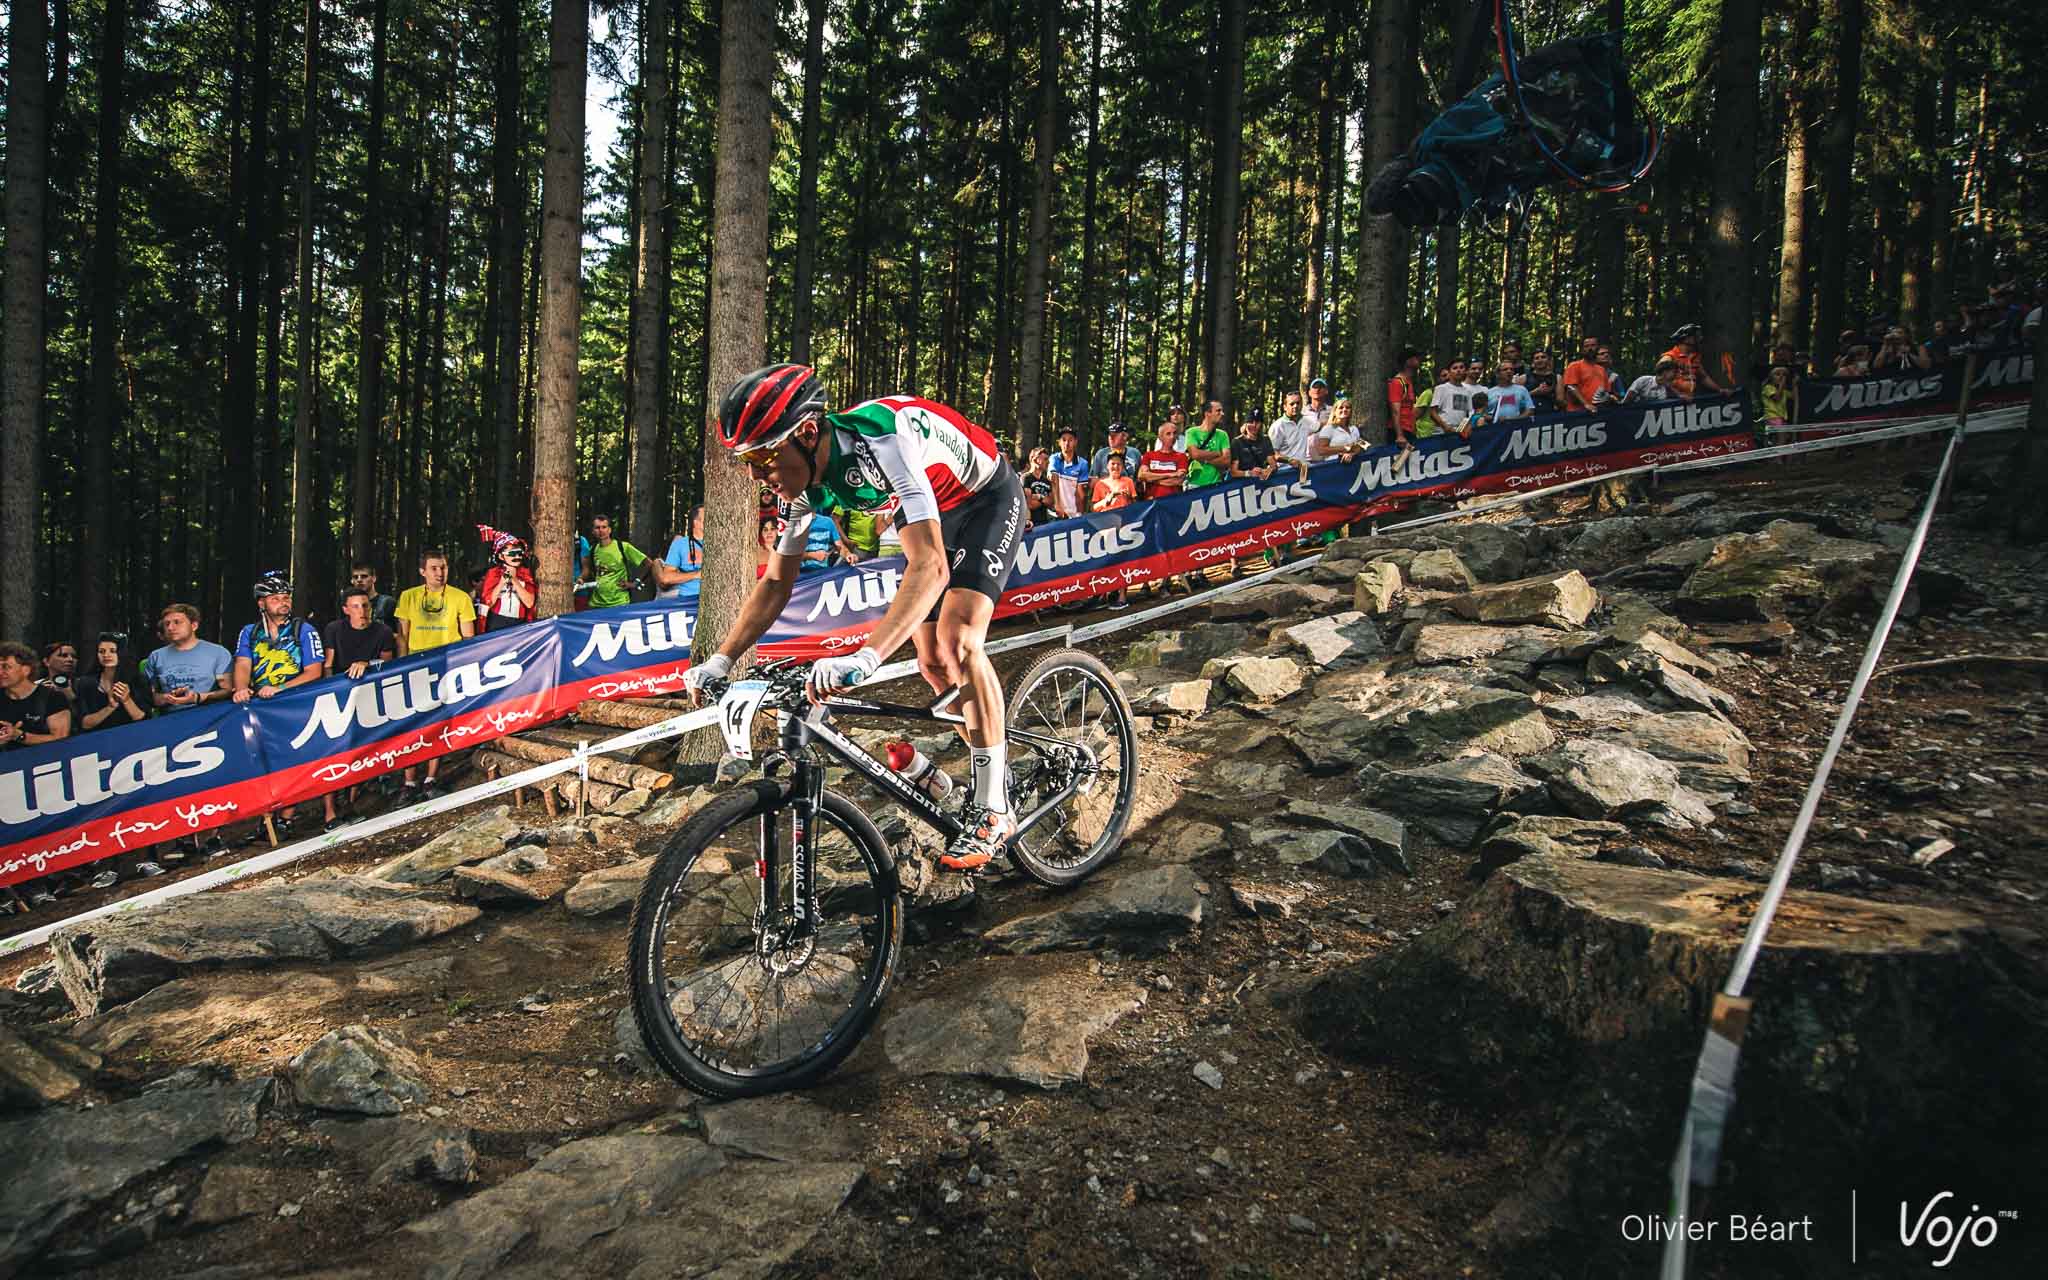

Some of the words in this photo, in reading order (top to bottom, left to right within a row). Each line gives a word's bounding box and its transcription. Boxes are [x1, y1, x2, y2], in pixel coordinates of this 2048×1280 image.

[1500, 422, 1607, 462] Mitas
[1635, 402, 1742, 440] Mitas
[1349, 445, 1475, 495] Mitas
[1505, 468, 1559, 488] Designed
[1563, 464, 1585, 480] for
[997, 496, 1021, 555] vaudoise
[1179, 477, 1318, 537] Mitas
[1011, 521, 1146, 576] Mitas
[1189, 536, 1258, 561] Designed
[1262, 528, 1288, 548] for
[1290, 520, 1321, 541] You
[806, 568, 902, 623] Mit
[1010, 580, 1084, 607] Designed
[1088, 569, 1118, 594] for
[1119, 566, 1151, 587] You
[571, 610, 697, 668] Mit
[290, 651, 524, 750] Mitas
[589, 667, 689, 698] Designed
[725, 700, 749, 735] 14
[311, 735, 433, 782] Designed
[439, 726, 483, 749] for
[108, 820, 170, 849] for
[175, 801, 238, 828] You
[797, 844, 806, 891] SWISS
